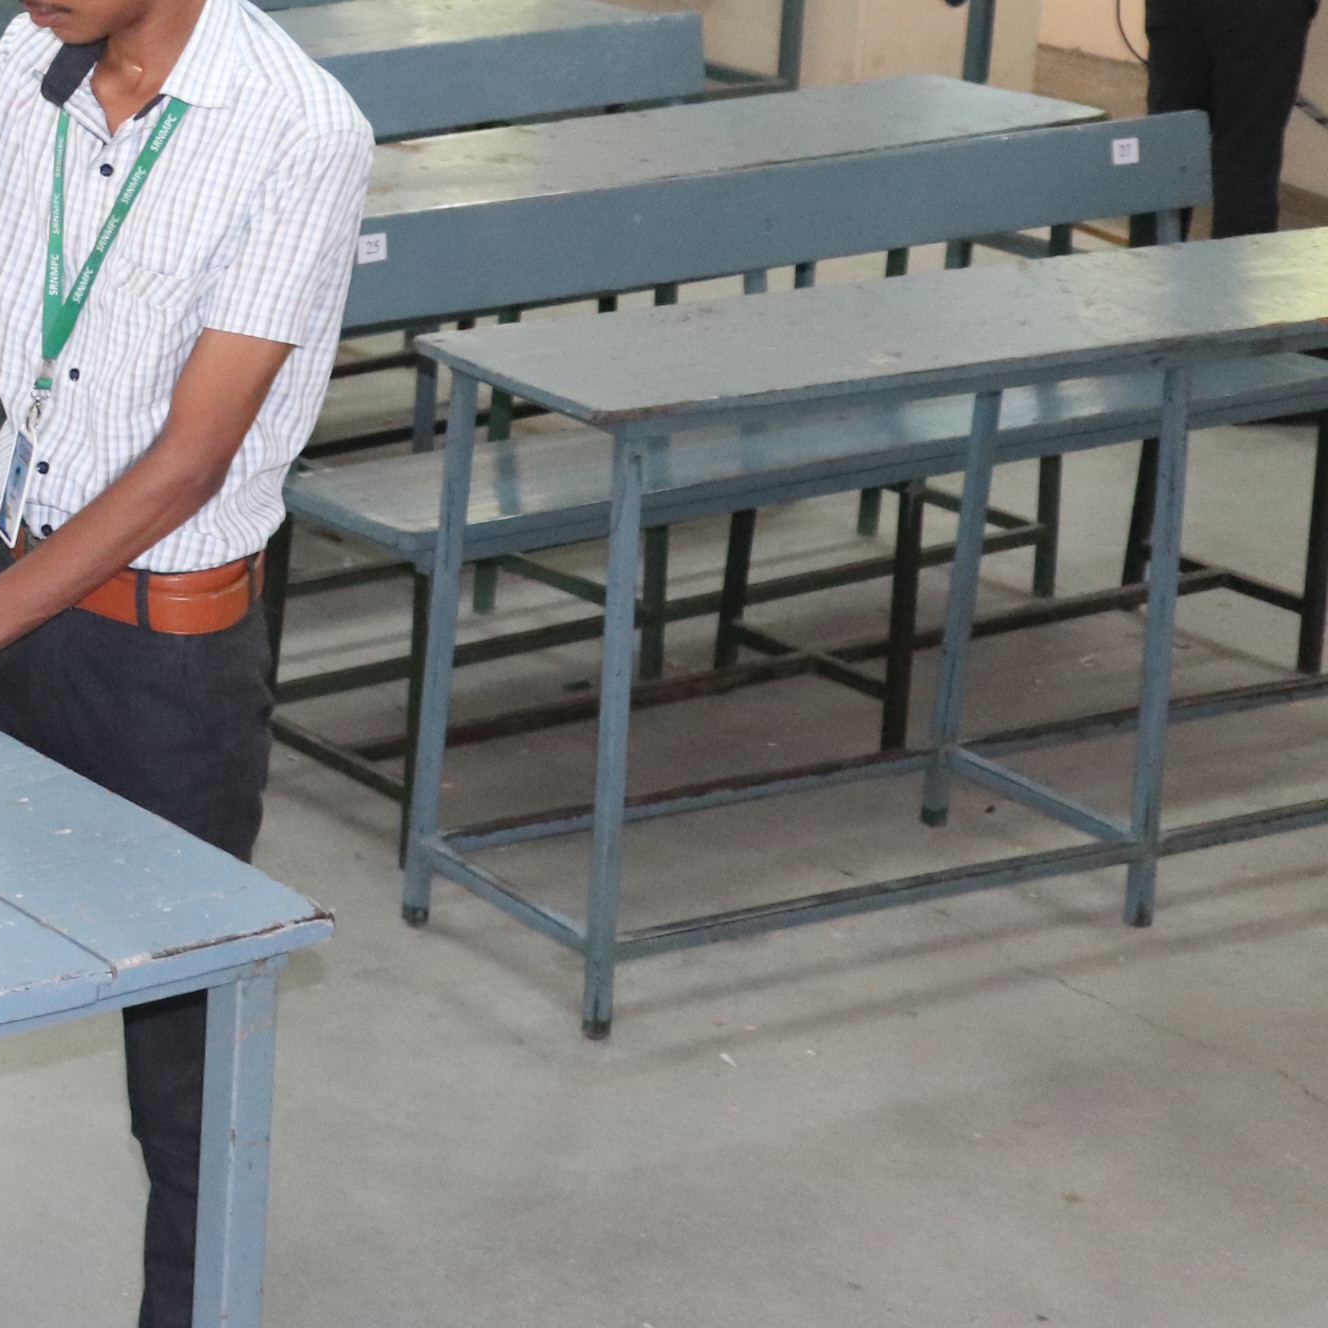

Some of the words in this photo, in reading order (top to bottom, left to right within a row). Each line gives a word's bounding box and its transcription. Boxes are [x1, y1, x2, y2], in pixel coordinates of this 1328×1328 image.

[150, 114, 178, 152] SRNMPC
[121, 166, 147, 205] SRNMPC
[96, 214, 120, 252] SRNMPC
[366, 240, 380, 255] 25
[48, 254, 60, 296] SRNMPC
[72, 265, 94, 304] SRNMPC
